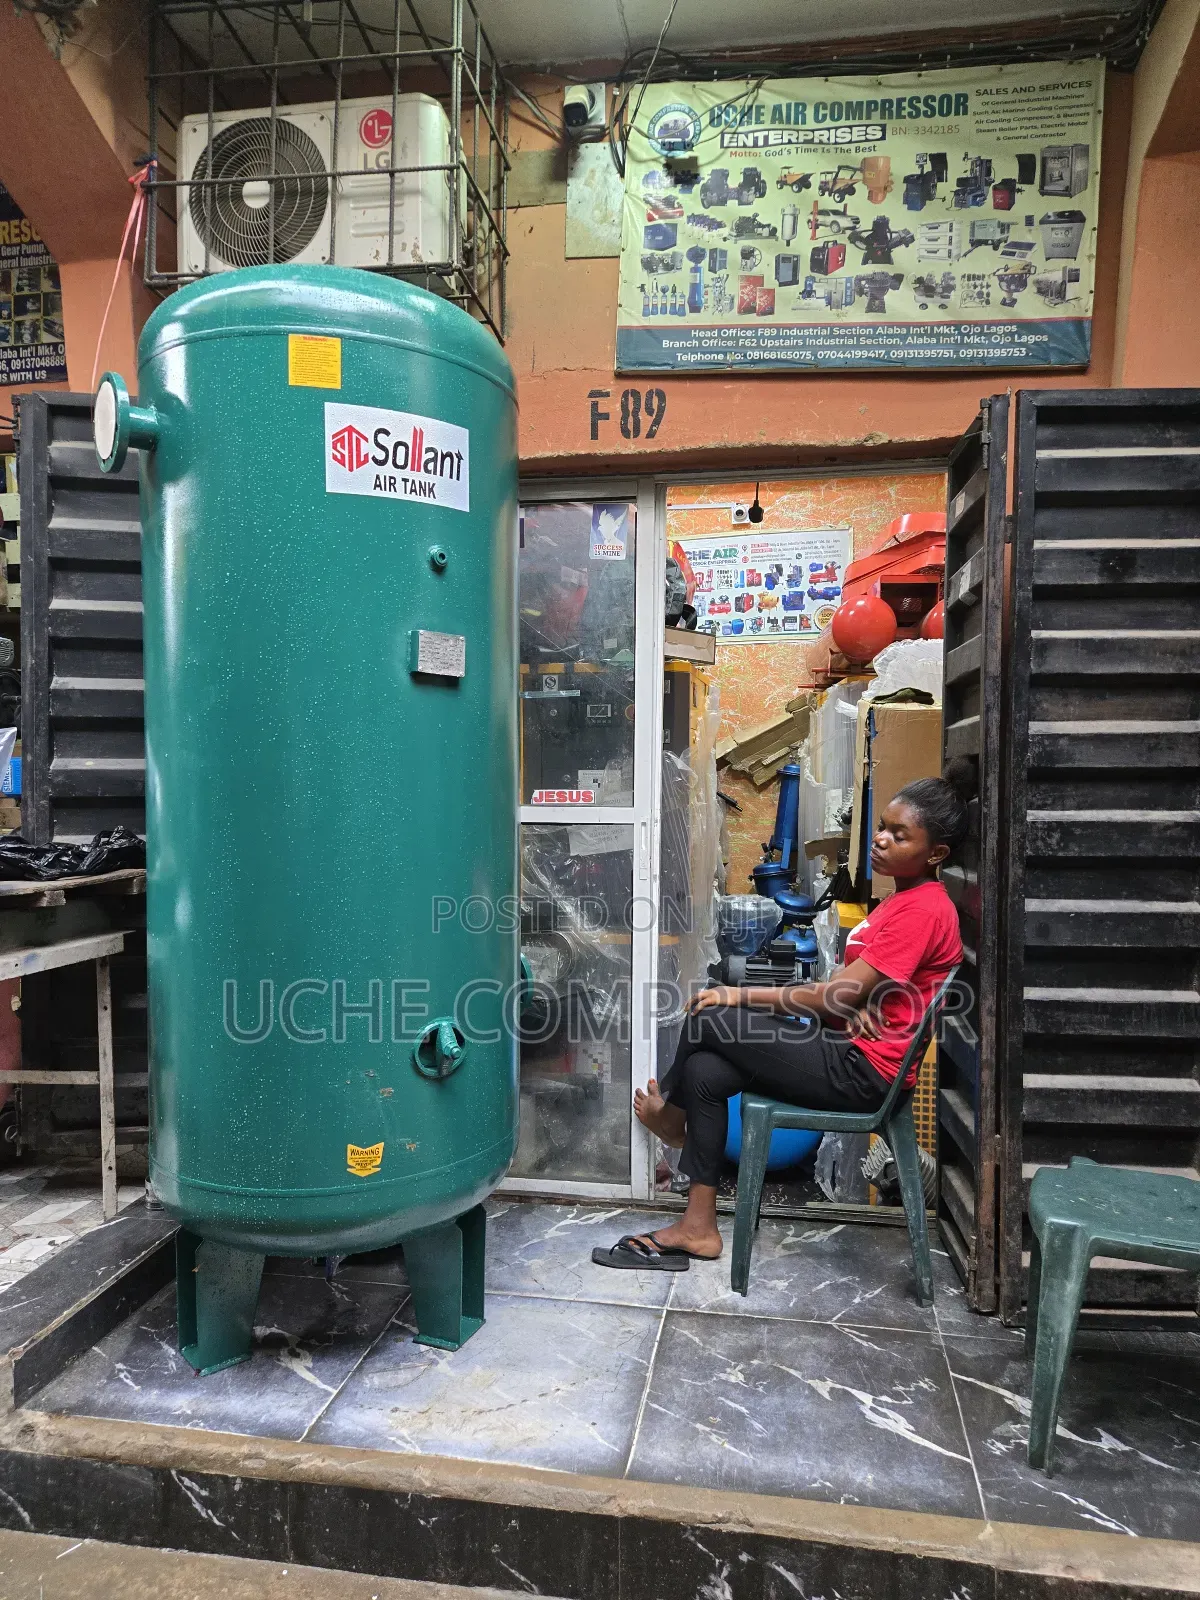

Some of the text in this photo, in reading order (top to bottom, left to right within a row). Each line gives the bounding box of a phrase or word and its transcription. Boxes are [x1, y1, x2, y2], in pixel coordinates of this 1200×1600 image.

[975, 80, 1092, 96] SALES AND SERVICES
[709, 92, 969, 128] UCHE AIR COMPRESSOR
[723, 124, 960, 148] ENTERPRISES BN: 3342185
[729, 150, 761, 158] Motto:
[764, 147, 791, 157] God's
[794, 146, 818, 154] Time
[833, 146, 852, 154] The
[855, 144, 877, 153] Best
[364, 151, 391, 170] LG
[1, 245, 20, 256] Gear
[691, 325, 1017, 338] Head Office: F89 Industrial Section Alaba Int'l Mkt, Ojo Lagos
[662, 334, 1048, 348] Branch Office: F62 Upstairs Industrial Section, Alaba Int'l Mkt, Ojo Lagos
[37, 345, 56, 356] Mkt,
[676, 352, 724, 362] Telphone
[746, 351, 815, 361] 08168165075,
[817, 350, 888, 361] 07044199417,
[890, 349, 956, 359] 09131395751,
[10, 371, 33, 381] WITH
[35, 370, 47, 379] US
[371, 426, 464, 481] Sollant
[373, 473, 437, 500] AIR TANK
[713, 547, 739, 560] AIR
[533, 790, 594, 803] JESUS
[350, 1147, 380, 1157] WARNING
